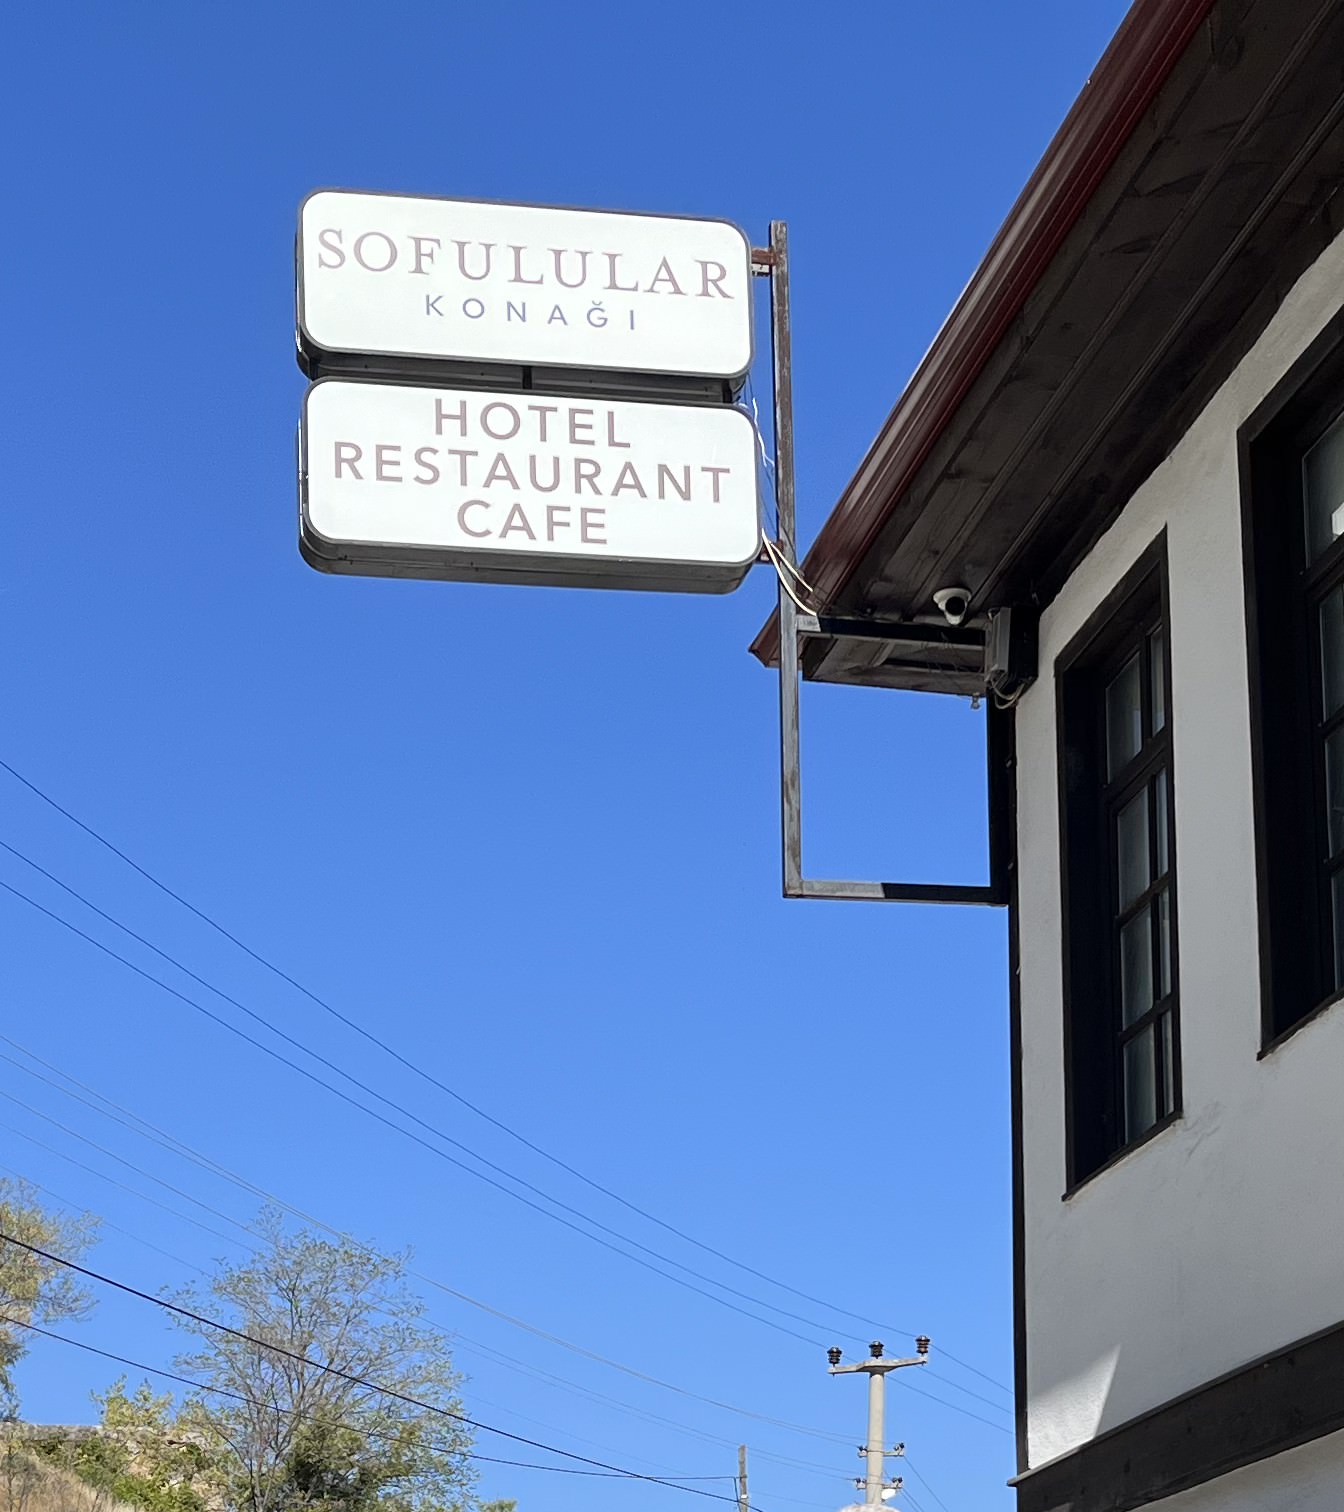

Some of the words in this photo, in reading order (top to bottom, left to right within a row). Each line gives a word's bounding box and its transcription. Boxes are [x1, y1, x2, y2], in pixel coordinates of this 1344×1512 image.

[318, 228, 735, 300] SOFULULAR
[425, 294, 636, 331] KONAĞI
[434, 397, 631, 449] HOTEL
[334, 441, 731, 504] RESTAURANT
[456, 499, 608, 545] CAFE
